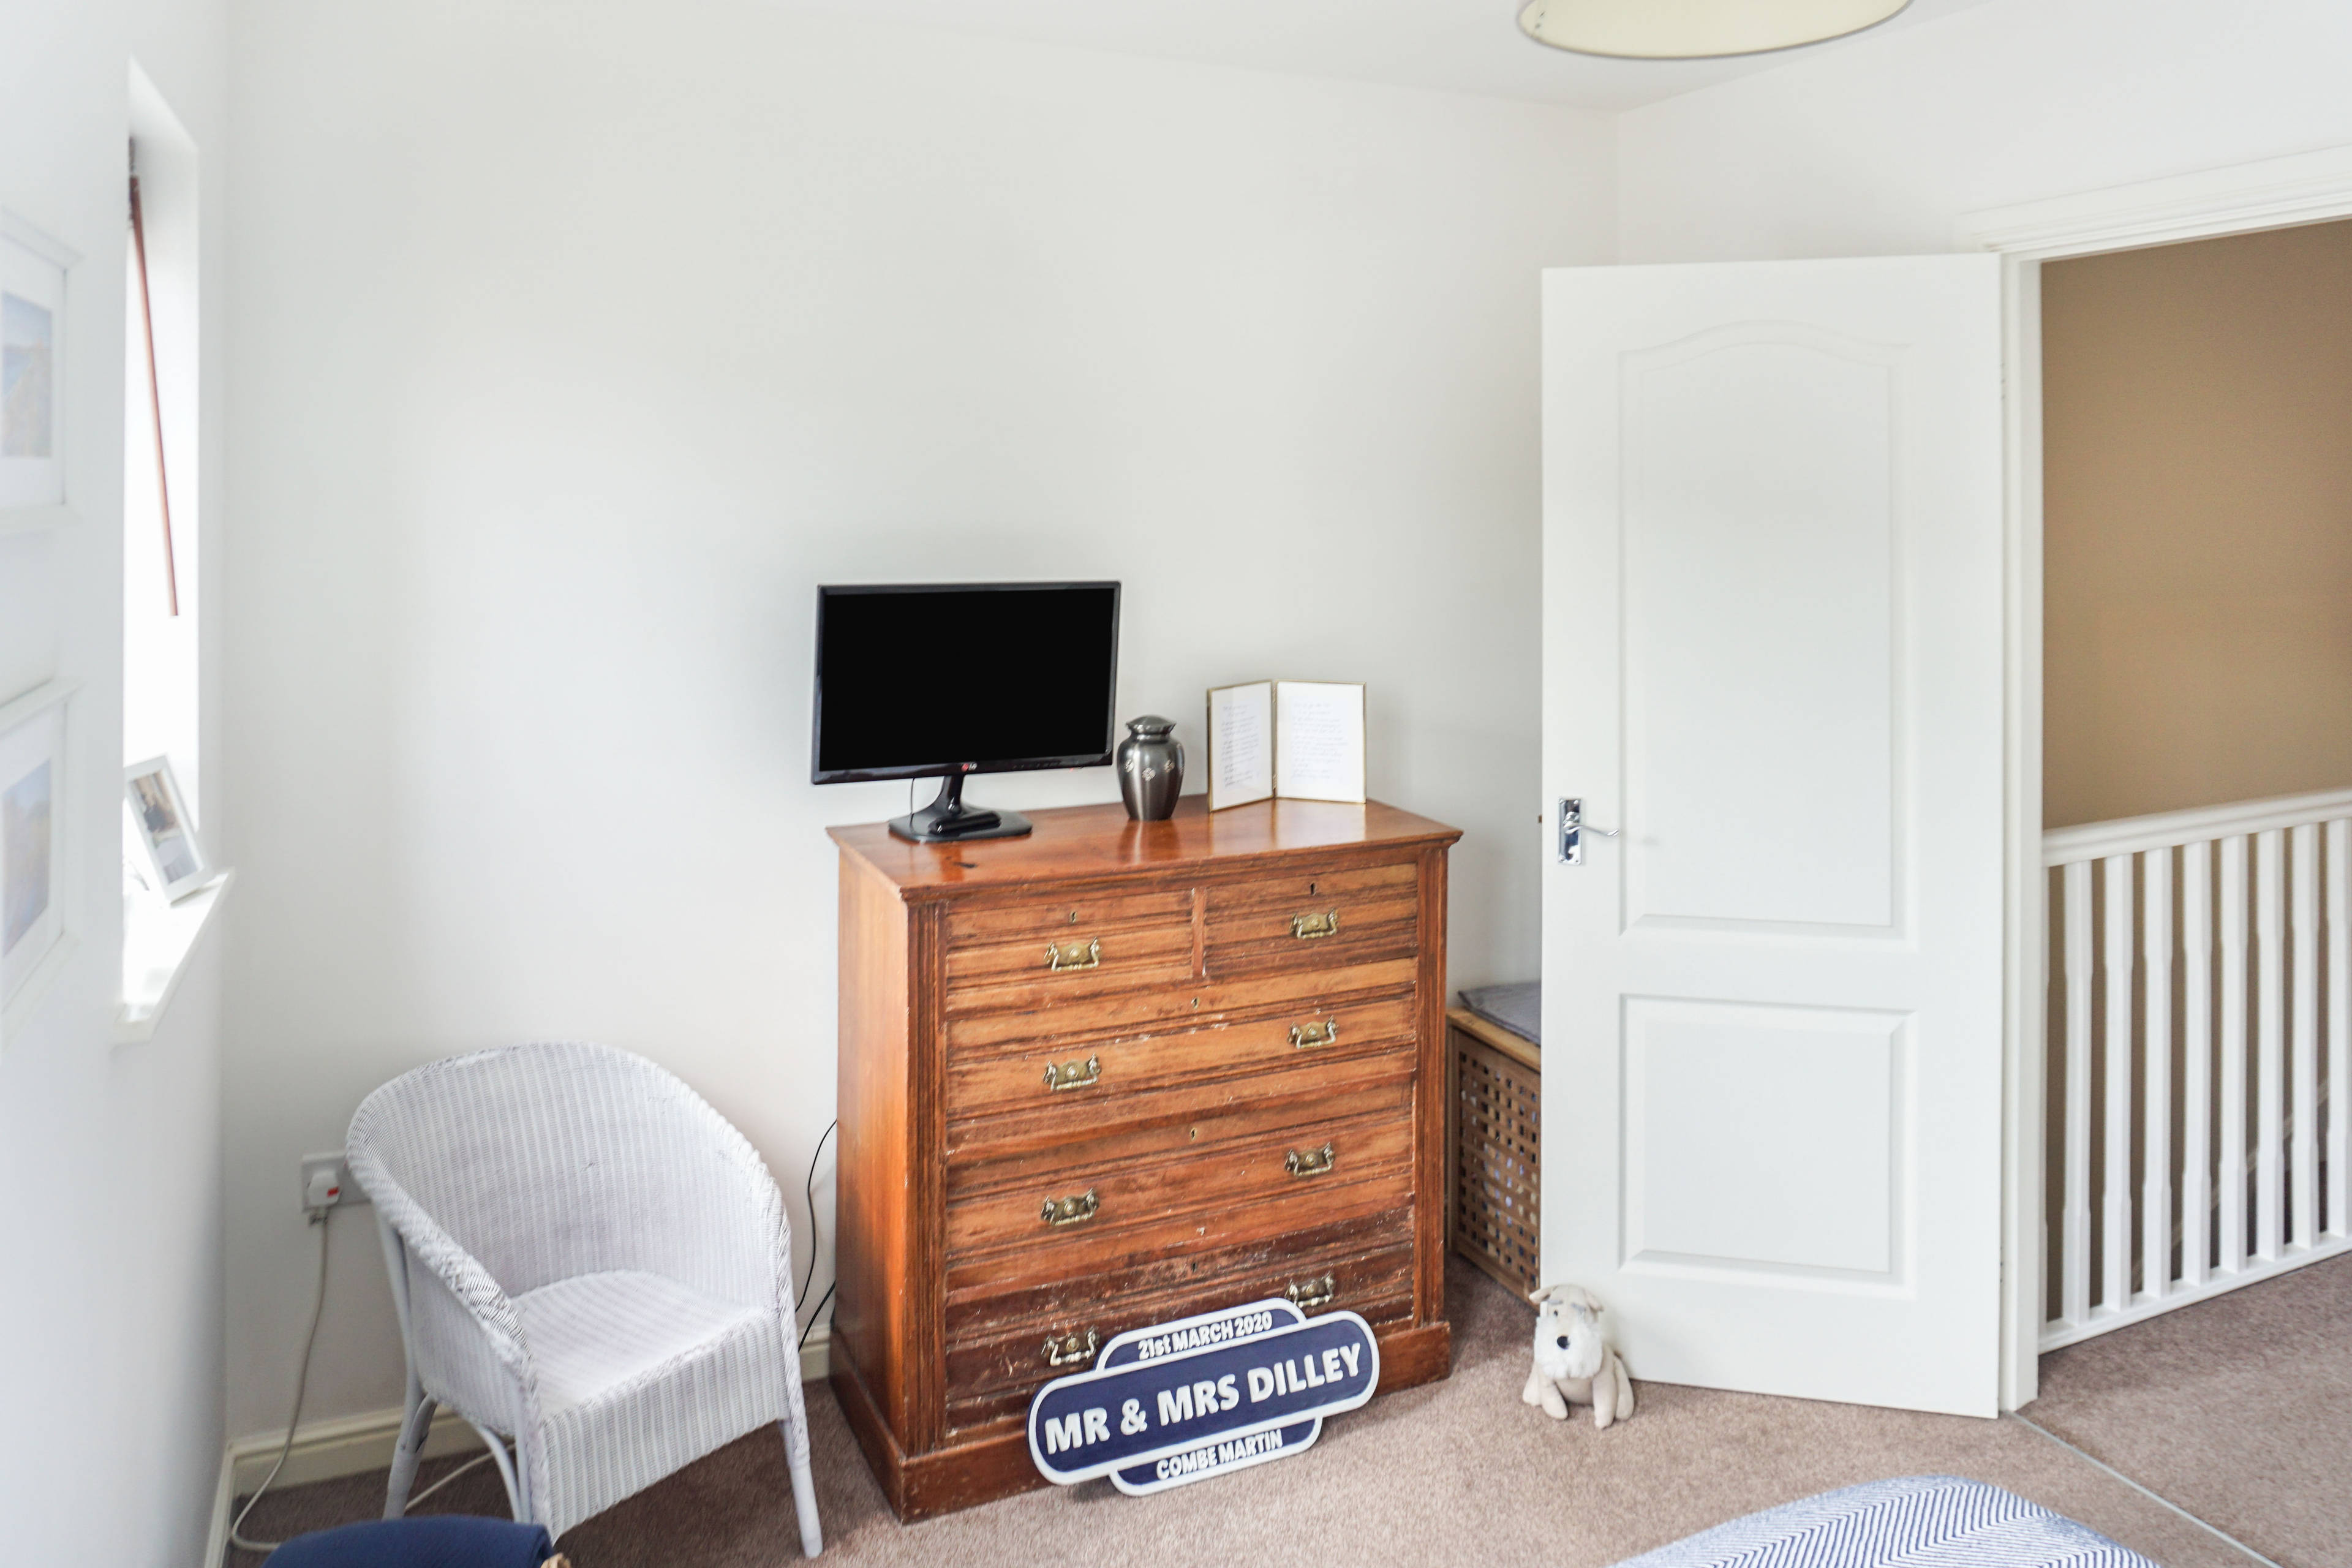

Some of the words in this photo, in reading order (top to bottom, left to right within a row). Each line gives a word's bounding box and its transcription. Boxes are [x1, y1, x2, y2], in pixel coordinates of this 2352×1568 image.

[1137, 1335, 1171, 1360] 21st
[1171, 1320, 1234, 1352] MARCH
[1234, 1311, 1273, 1338] 2020
[1045, 1408, 1110, 1455] MR
[1120, 1398, 1148, 1436] &
[1157, 1374, 1240, 1426] MRS
[1247, 1342, 1361, 1403] DILLEY
[1156, 1447, 1218, 1480] COMBE
[1219, 1429, 1283, 1464] MARTIN
